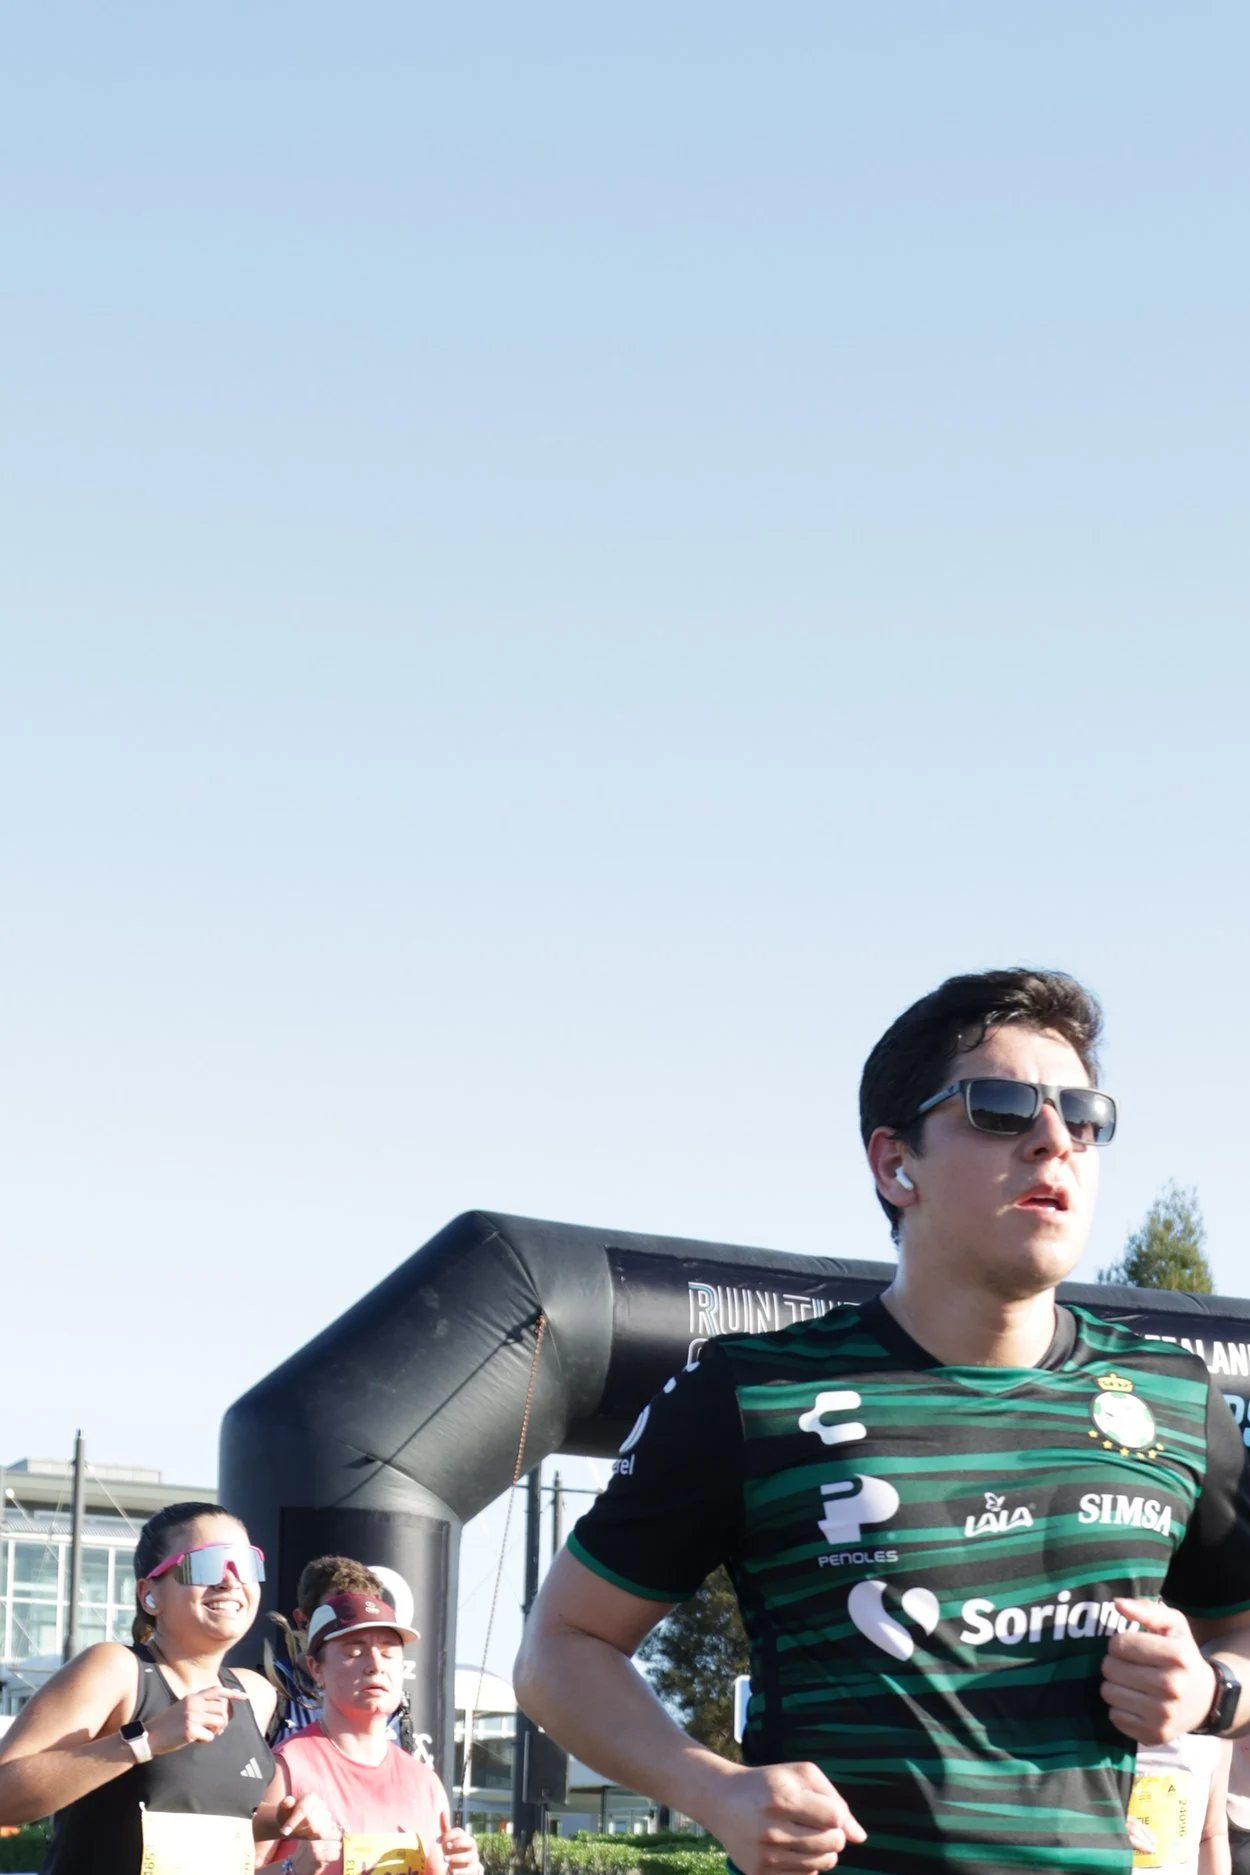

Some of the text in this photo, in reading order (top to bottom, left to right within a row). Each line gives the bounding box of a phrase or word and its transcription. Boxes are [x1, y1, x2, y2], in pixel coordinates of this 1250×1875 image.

[687, 1281, 779, 1335] RUN
[964, 1505, 1034, 1538] LALA
[1078, 1493, 1172, 1537] SIMSA
